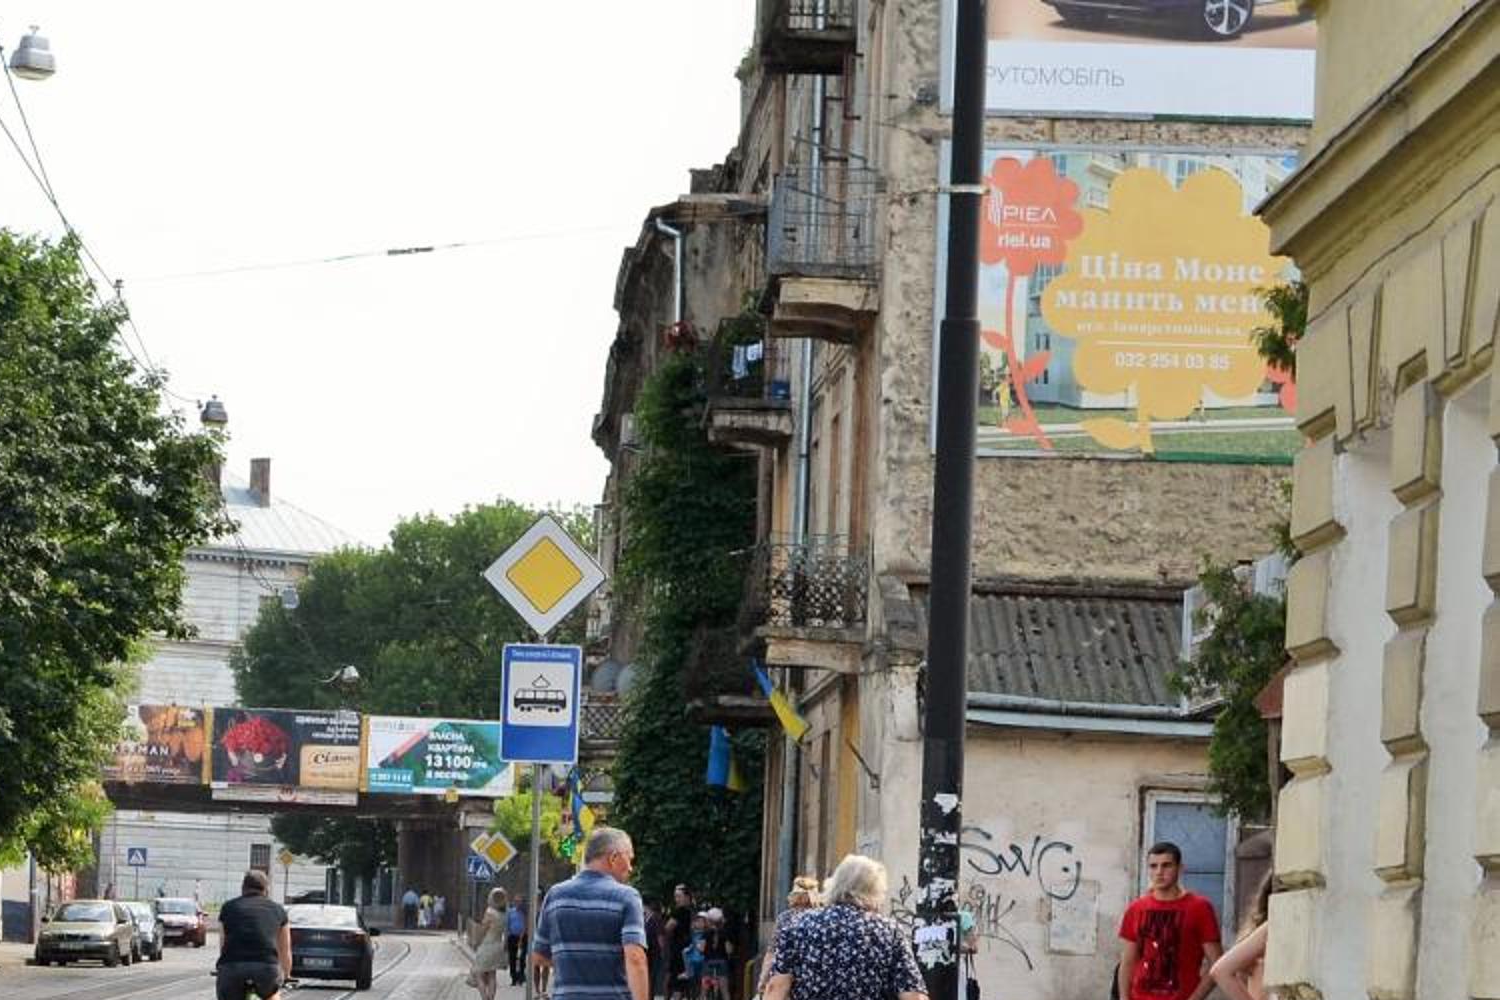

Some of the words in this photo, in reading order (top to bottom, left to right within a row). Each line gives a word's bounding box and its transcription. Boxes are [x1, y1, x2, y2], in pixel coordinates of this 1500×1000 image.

[999, 232, 1051, 249] riel.ua
[1081, 254, 1163, 283] Ціна
[1174, 257, 1265, 284] Моне
[1055, 289, 1184, 313] манить
[1195, 293, 1265, 314] мен
[1115, 351, 1146, 367] 032
[428, 743, 475, 754] КВАРТИРА
